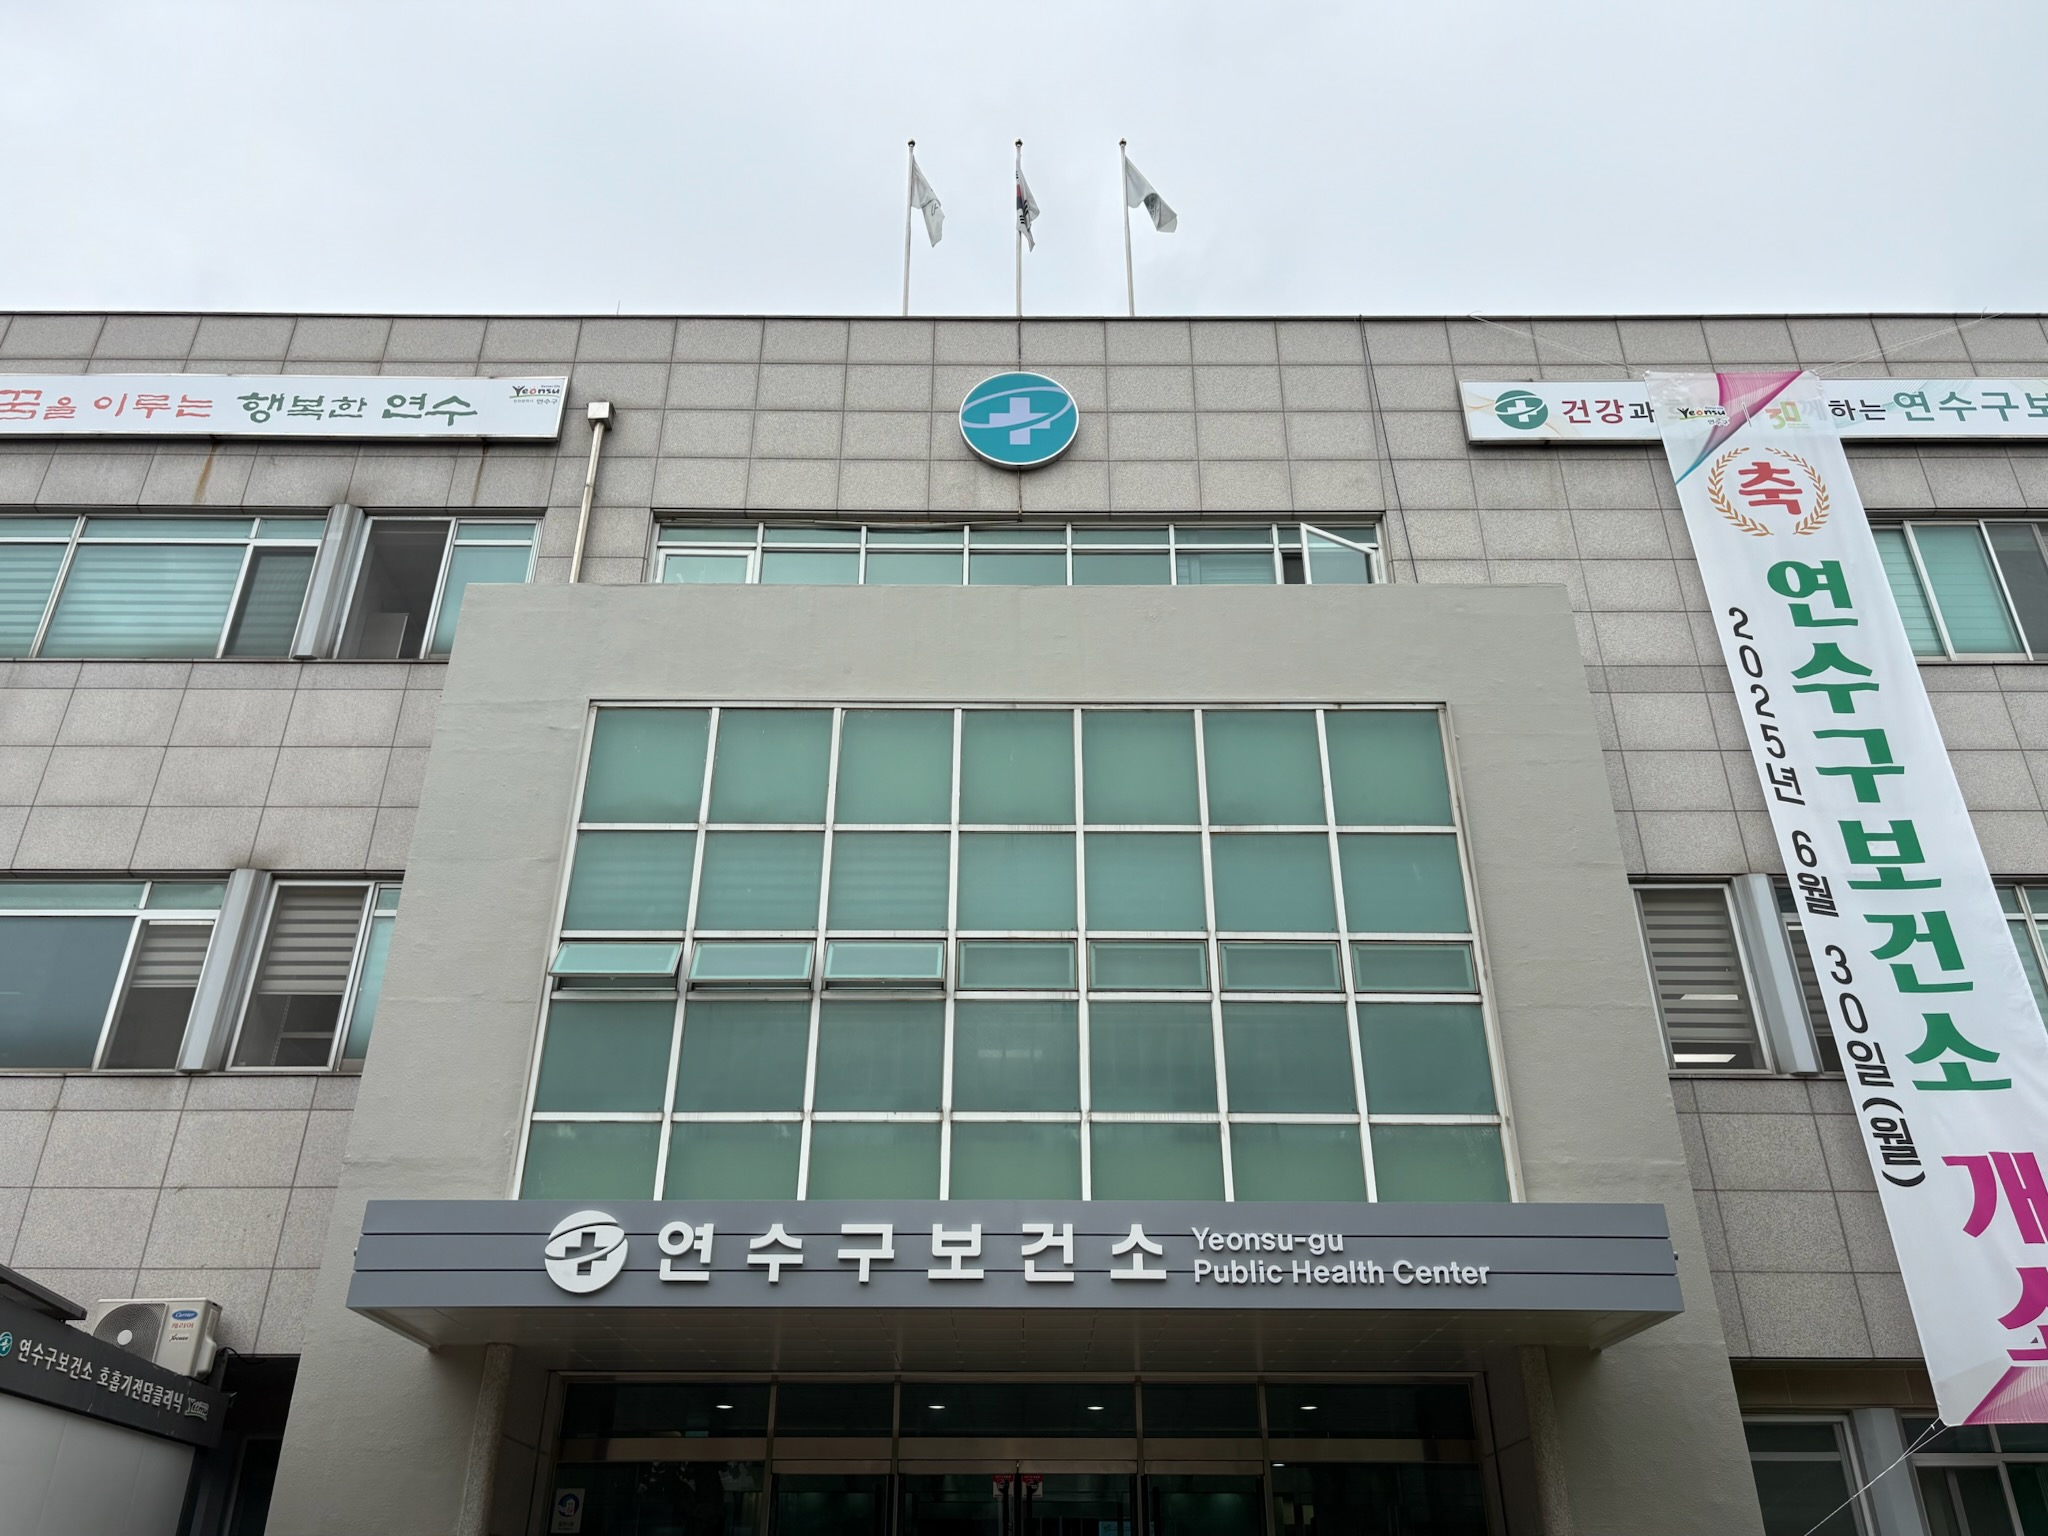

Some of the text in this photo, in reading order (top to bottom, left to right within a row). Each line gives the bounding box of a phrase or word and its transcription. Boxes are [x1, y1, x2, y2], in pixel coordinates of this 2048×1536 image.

[512, 385, 560, 397] Yeonsu
[93, 393, 214, 419] 이루는
[237, 392, 368, 423] 행복한
[382, 393, 478, 426] 연수
[1561, 399, 1655, 424] 건강과
[1677, 407, 1726, 419] Yeonsu
[1738, 462, 1803, 515] 축
[1728, 607, 1806, 806] 2025년
[1791, 829, 1839, 918] 6월
[1767, 559, 2012, 1092] 연수구보건소
[657, 1220, 1168, 1284] 연수구보건소
[1191, 1227, 1345, 1256] Yeonsu-gu
[1194, 1259, 1490, 1286] Public Health Center
[18, 1338, 185, 1414] 연수구보건소 호흡기전담클리닉
